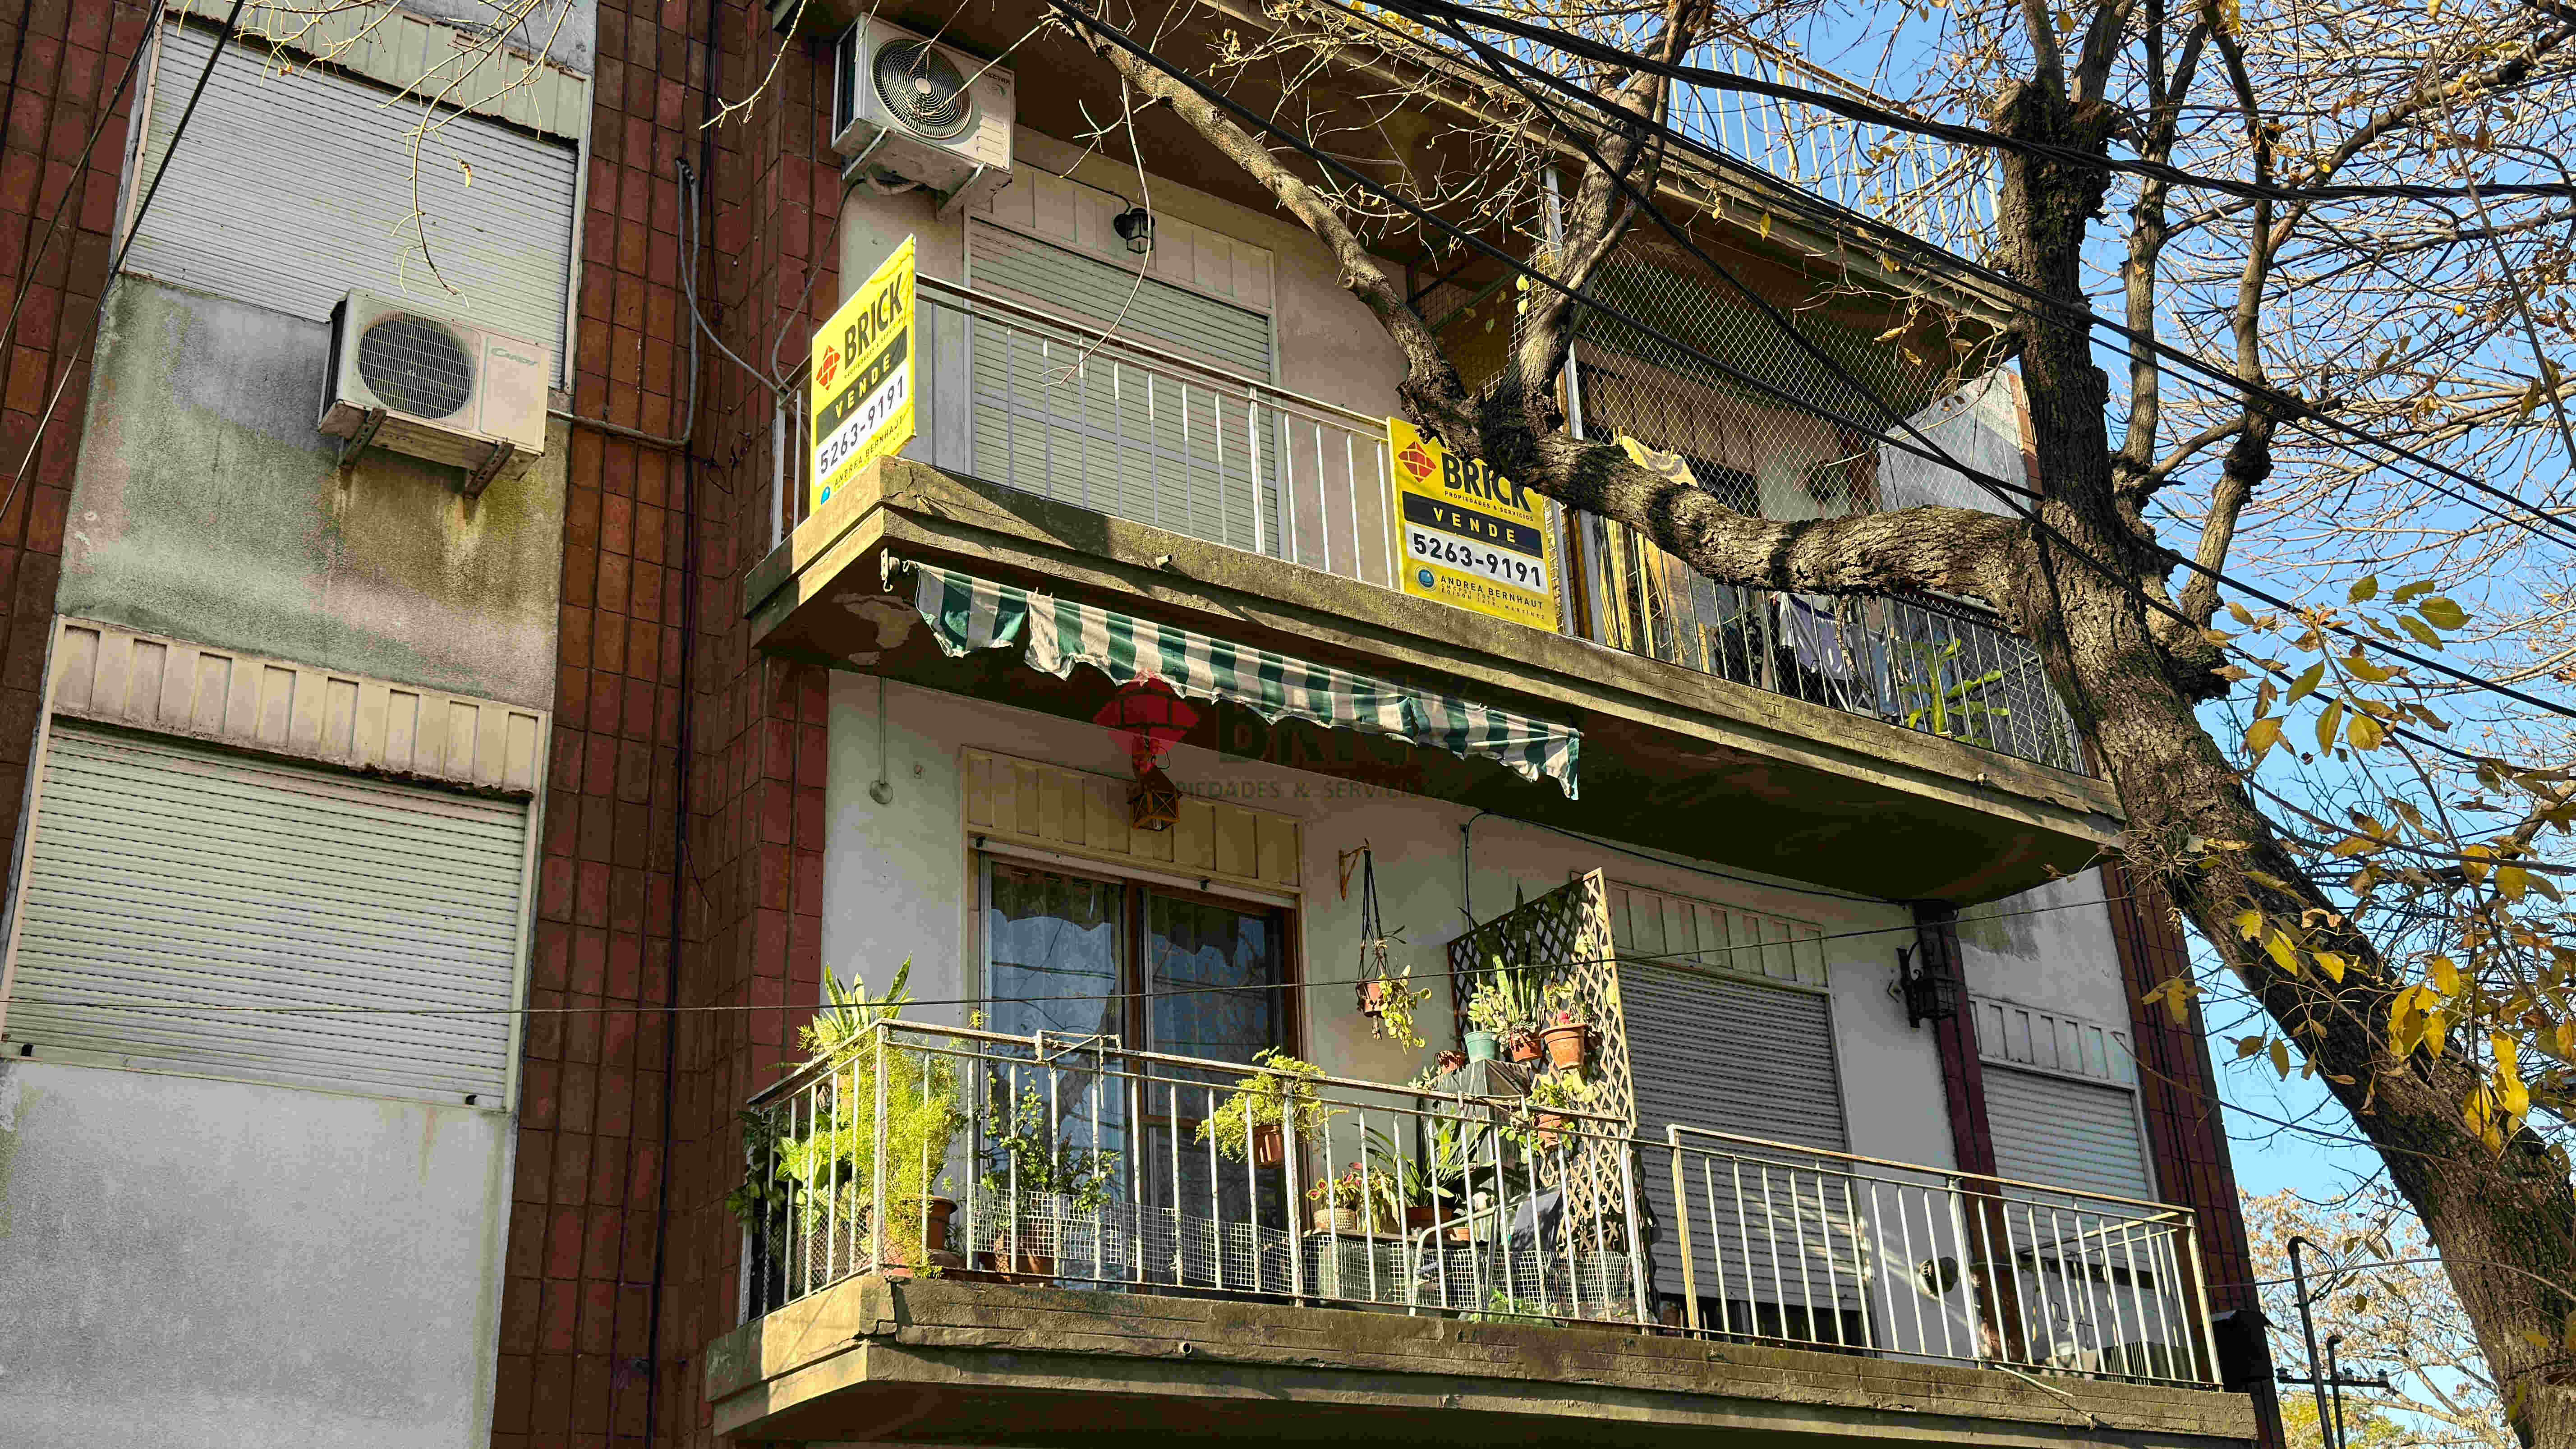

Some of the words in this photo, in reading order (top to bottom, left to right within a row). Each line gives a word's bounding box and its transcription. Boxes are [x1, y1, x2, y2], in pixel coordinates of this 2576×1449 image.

[845, 272, 902, 370] BRICK
[836, 353, 890, 419] VENDE
[821, 376, 902, 474] 5263-9191
[835, 456, 863, 485] ANDREA
[866, 416, 903, 458] BERNHAUT
[1442, 452, 1532, 512] BRICK
[1444, 490, 1490, 508] PROPIEDADES
[1500, 508, 1534, 522] SERVICIOS
[1433, 507, 1516, 543] VENDE
[1413, 533, 1541, 587] 5263-9191
[1440, 575, 1483, 593] ANDREA
[1488, 588, 1543, 609] BERNHAUT
